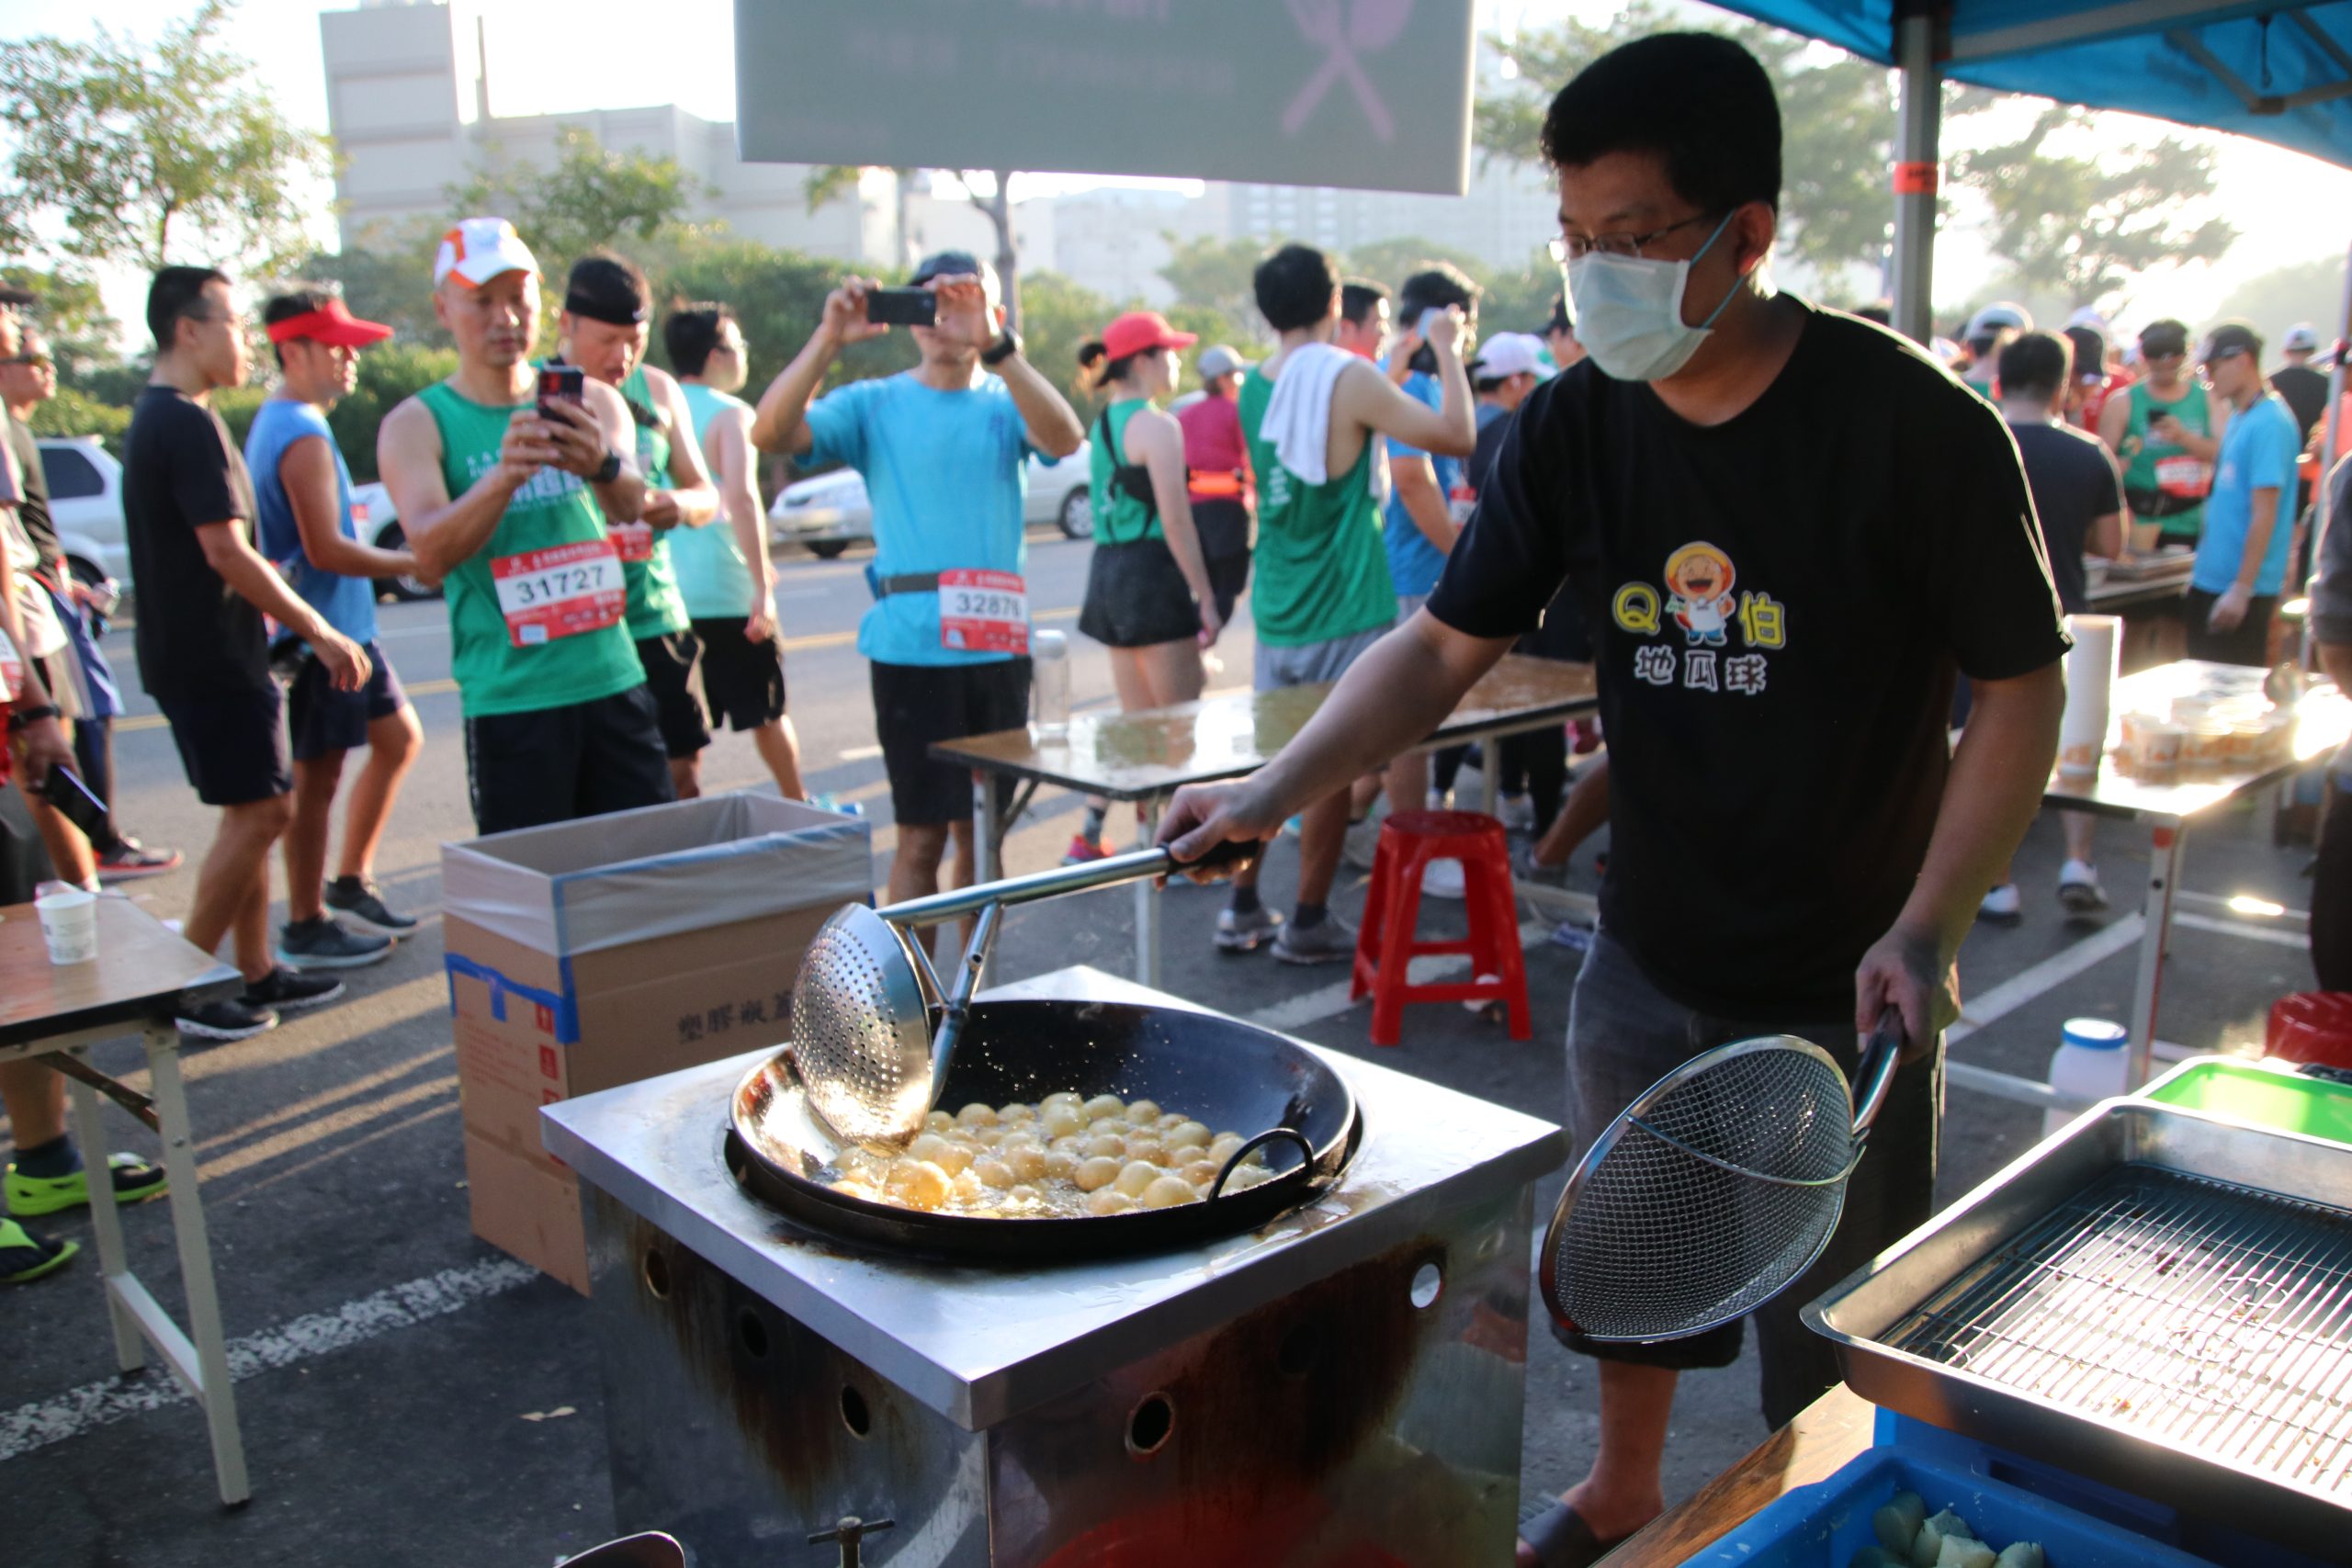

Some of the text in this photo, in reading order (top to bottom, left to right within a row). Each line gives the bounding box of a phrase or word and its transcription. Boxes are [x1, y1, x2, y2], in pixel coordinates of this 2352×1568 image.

[516, 565, 604, 604] 31727
[1634, 644, 1767, 695] 地瓜球
